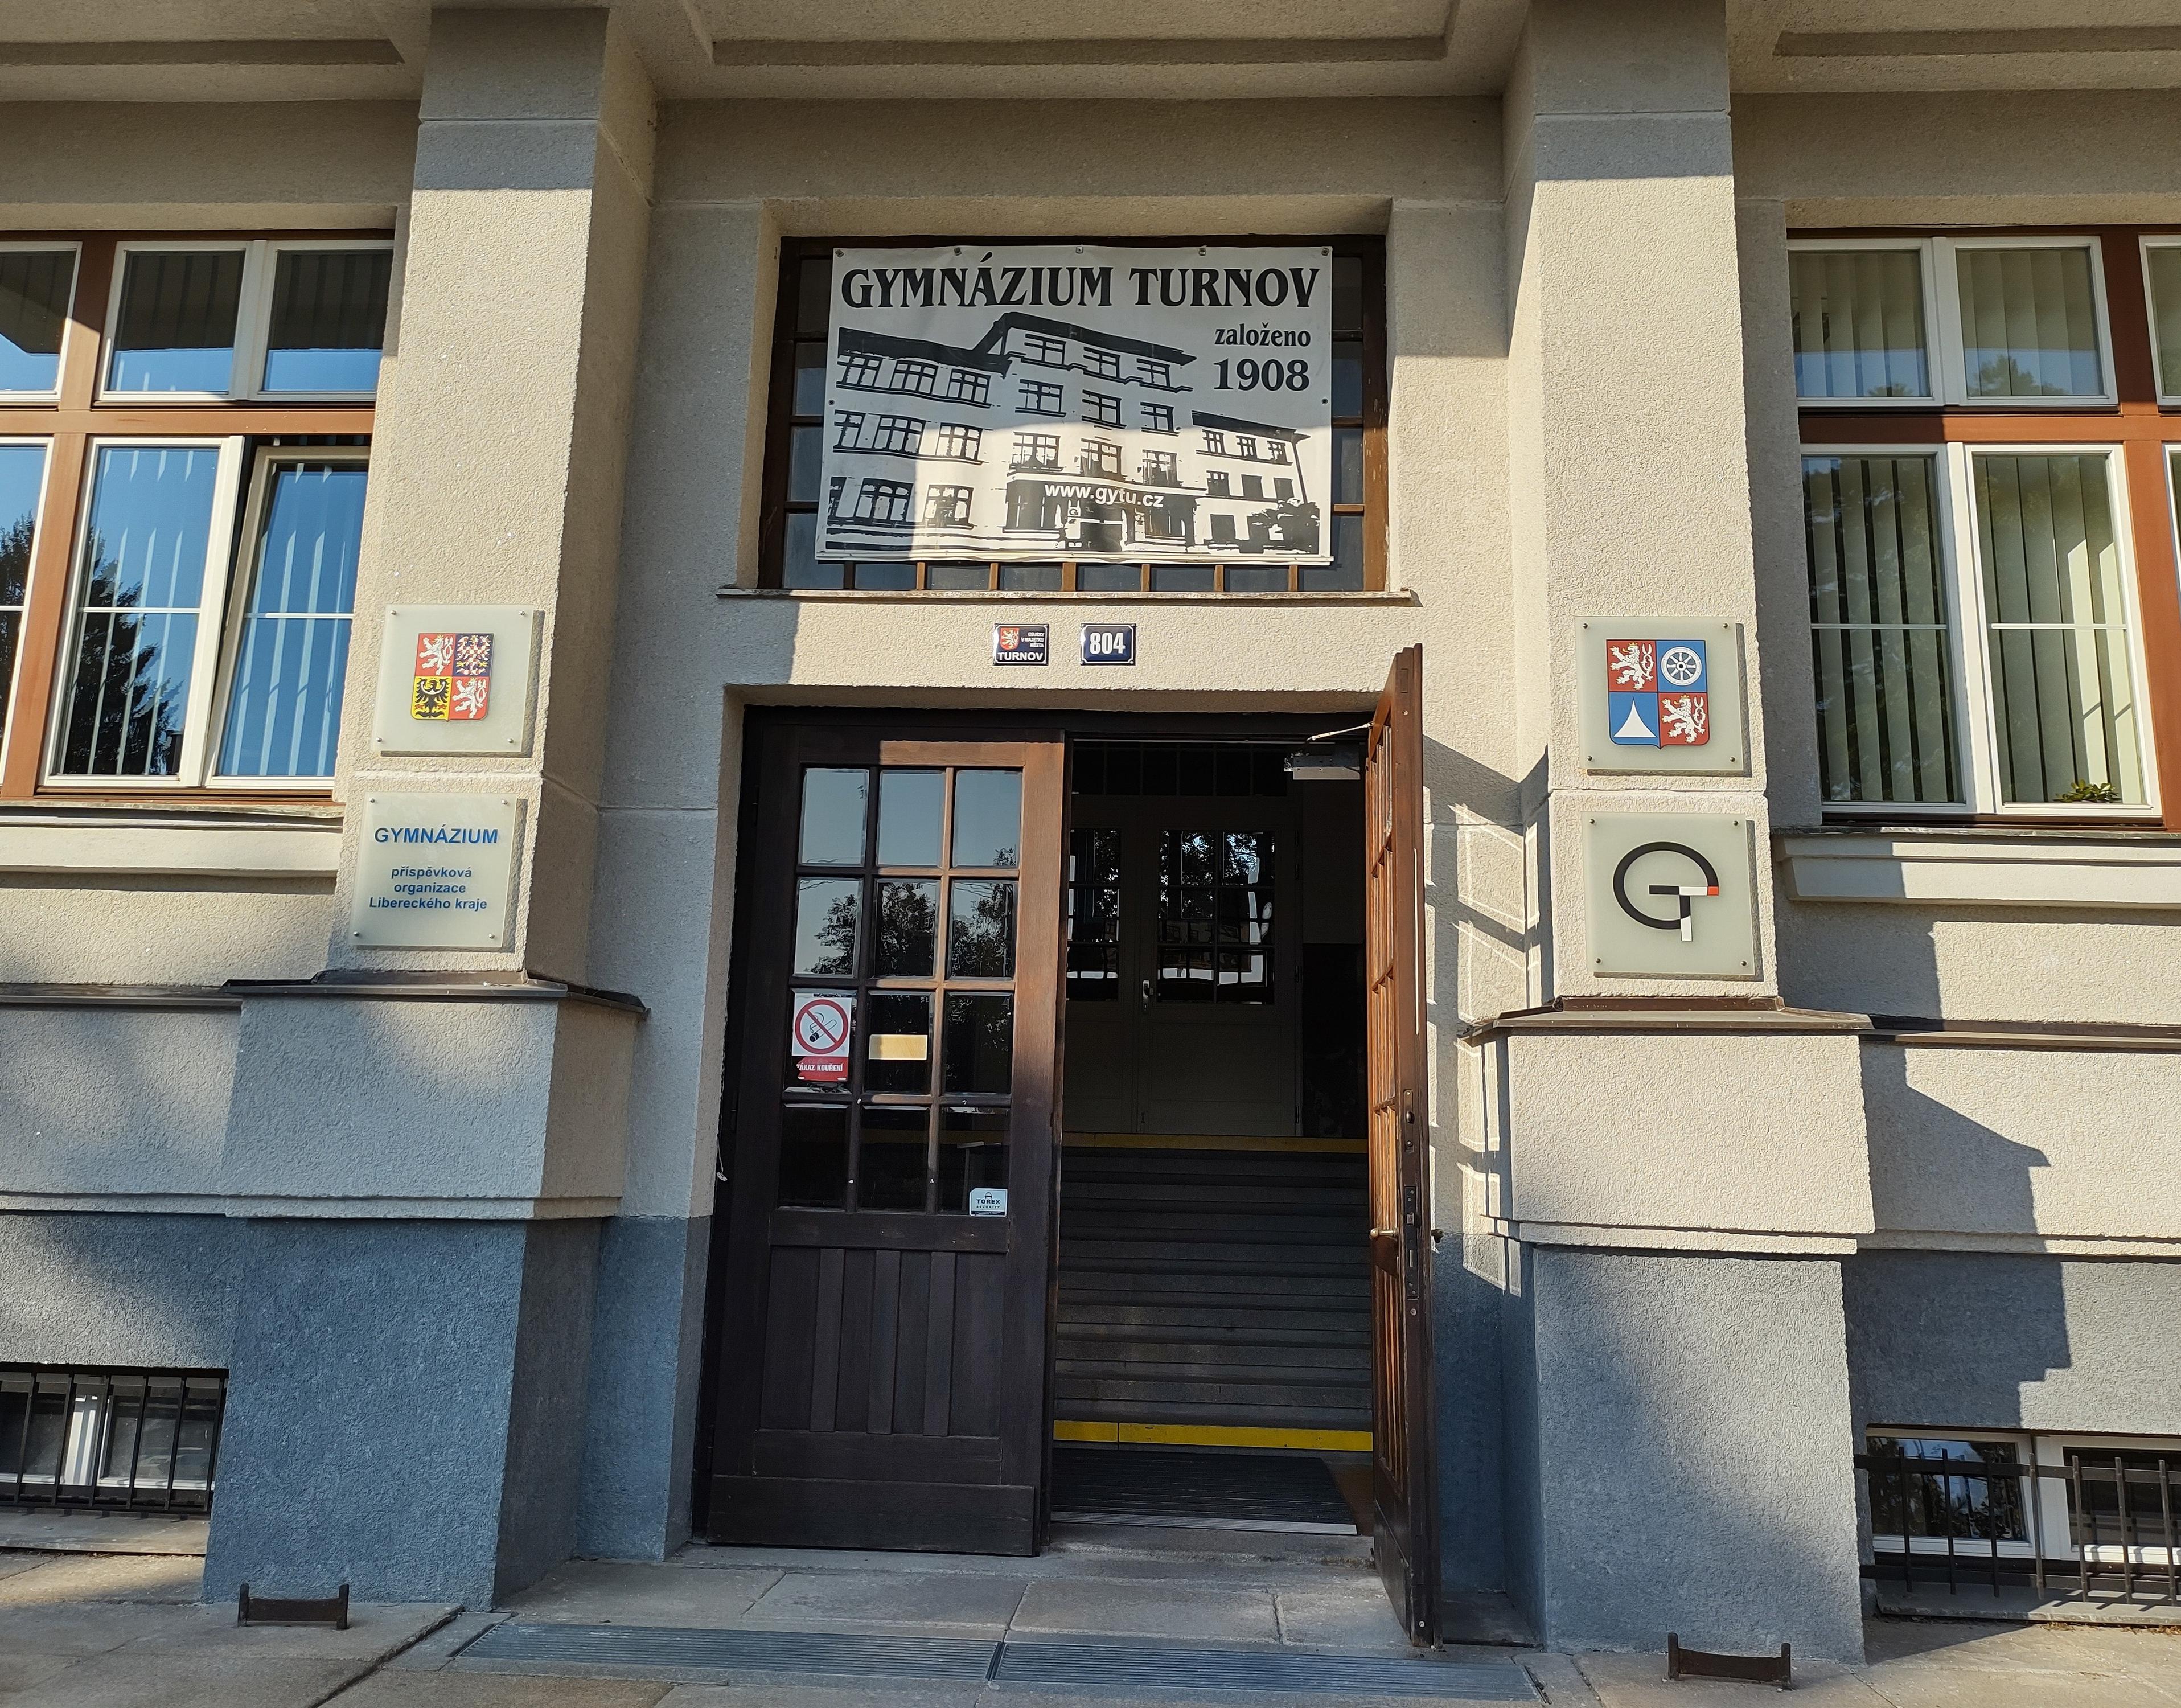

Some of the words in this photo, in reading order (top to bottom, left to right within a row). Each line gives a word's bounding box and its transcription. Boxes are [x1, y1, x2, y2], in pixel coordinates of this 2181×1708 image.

[841, 251, 1114, 309] GYMNÁZIUM
[1128, 268, 1320, 307] TURNOV
[1214, 322, 1311, 347] založeno
[1213, 358, 1310, 392] 1908
[1044, 484, 1164, 508] www.gytu.cz
[1090, 632, 1126, 655] 804
[997, 652, 1044, 661] TURNOV
[374, 824, 498, 844] GYMNÁZIUM
[391, 866, 472, 880] příspěvková
[394, 882, 466, 896] organizace
[369, 897, 451, 909] Libereckého
[455, 898, 487, 912] kraje
[816, 1062, 844, 1071] KOUŘENÍ
